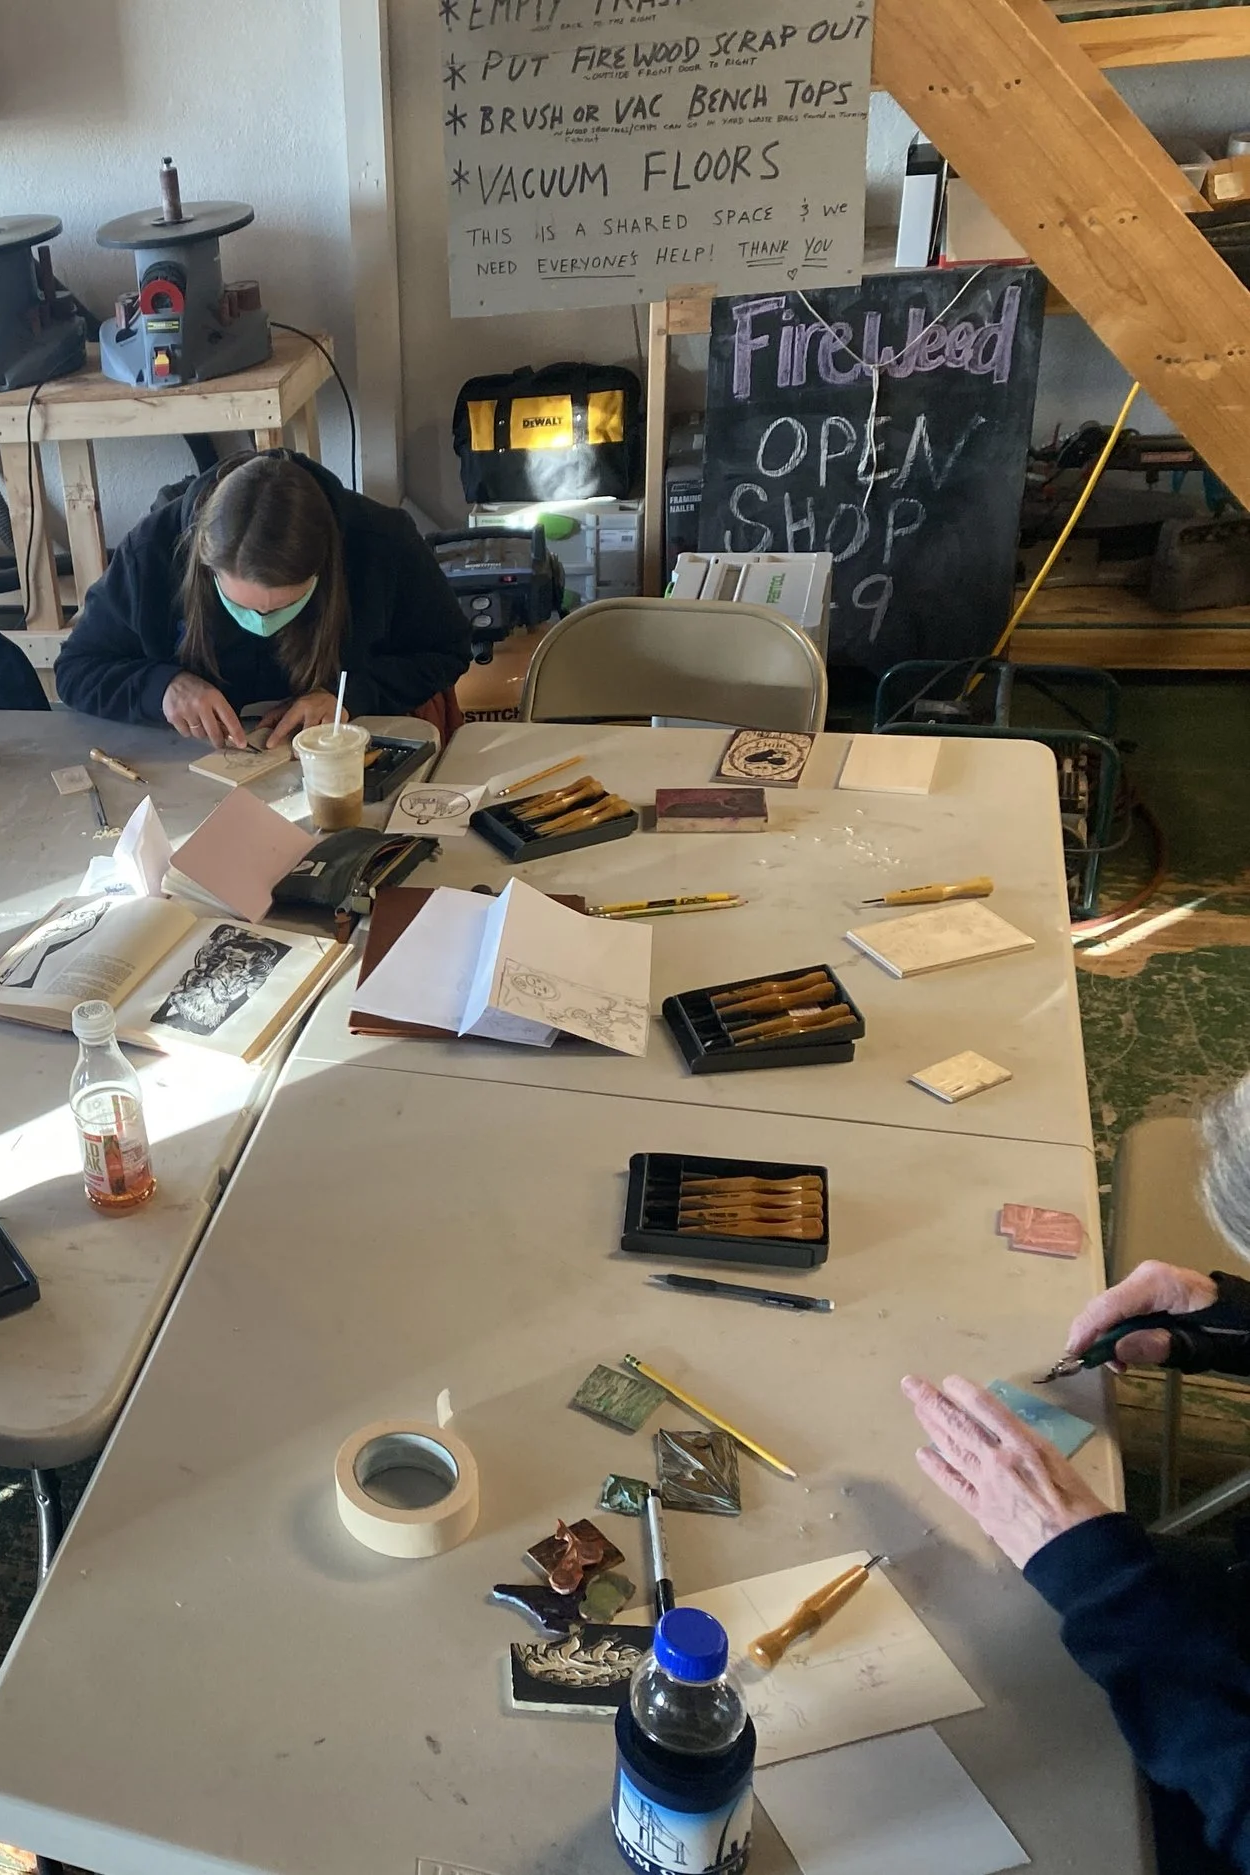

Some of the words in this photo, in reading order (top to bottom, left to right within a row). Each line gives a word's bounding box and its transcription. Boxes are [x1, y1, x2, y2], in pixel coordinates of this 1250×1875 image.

[482, 50, 549, 82] PUT
[709, 24, 797, 57] SCRAP
[807, 15, 869, 44] OUT
[725, 57, 757, 67] RIGHT
[480, 103, 563, 136] BRUSH
[573, 104, 600, 122] OR
[615, 93, 662, 124] VAC
[687, 83, 767, 120] BENCH
[785, 79, 853, 109] TOPS
[478, 161, 608, 205] VACUUM
[643, 141, 780, 192] FLOORS
[466, 228, 512, 246] THIS
[538, 226, 556, 243] IS
[576, 223, 586, 236] A
[604, 215, 688, 236] SHARED
[713, 207, 774, 227] SPACE
[477, 262, 517, 276] NEED
[656, 245, 715, 265] HELP!
[738, 239, 790, 258] THANK
[804, 238, 833, 254] YOU
[756, 413, 987, 490] OPEN
[670, 494, 702, 504] FRAMING
[670, 504, 695, 513] NAILER
[724, 483, 927, 564] SHOP
